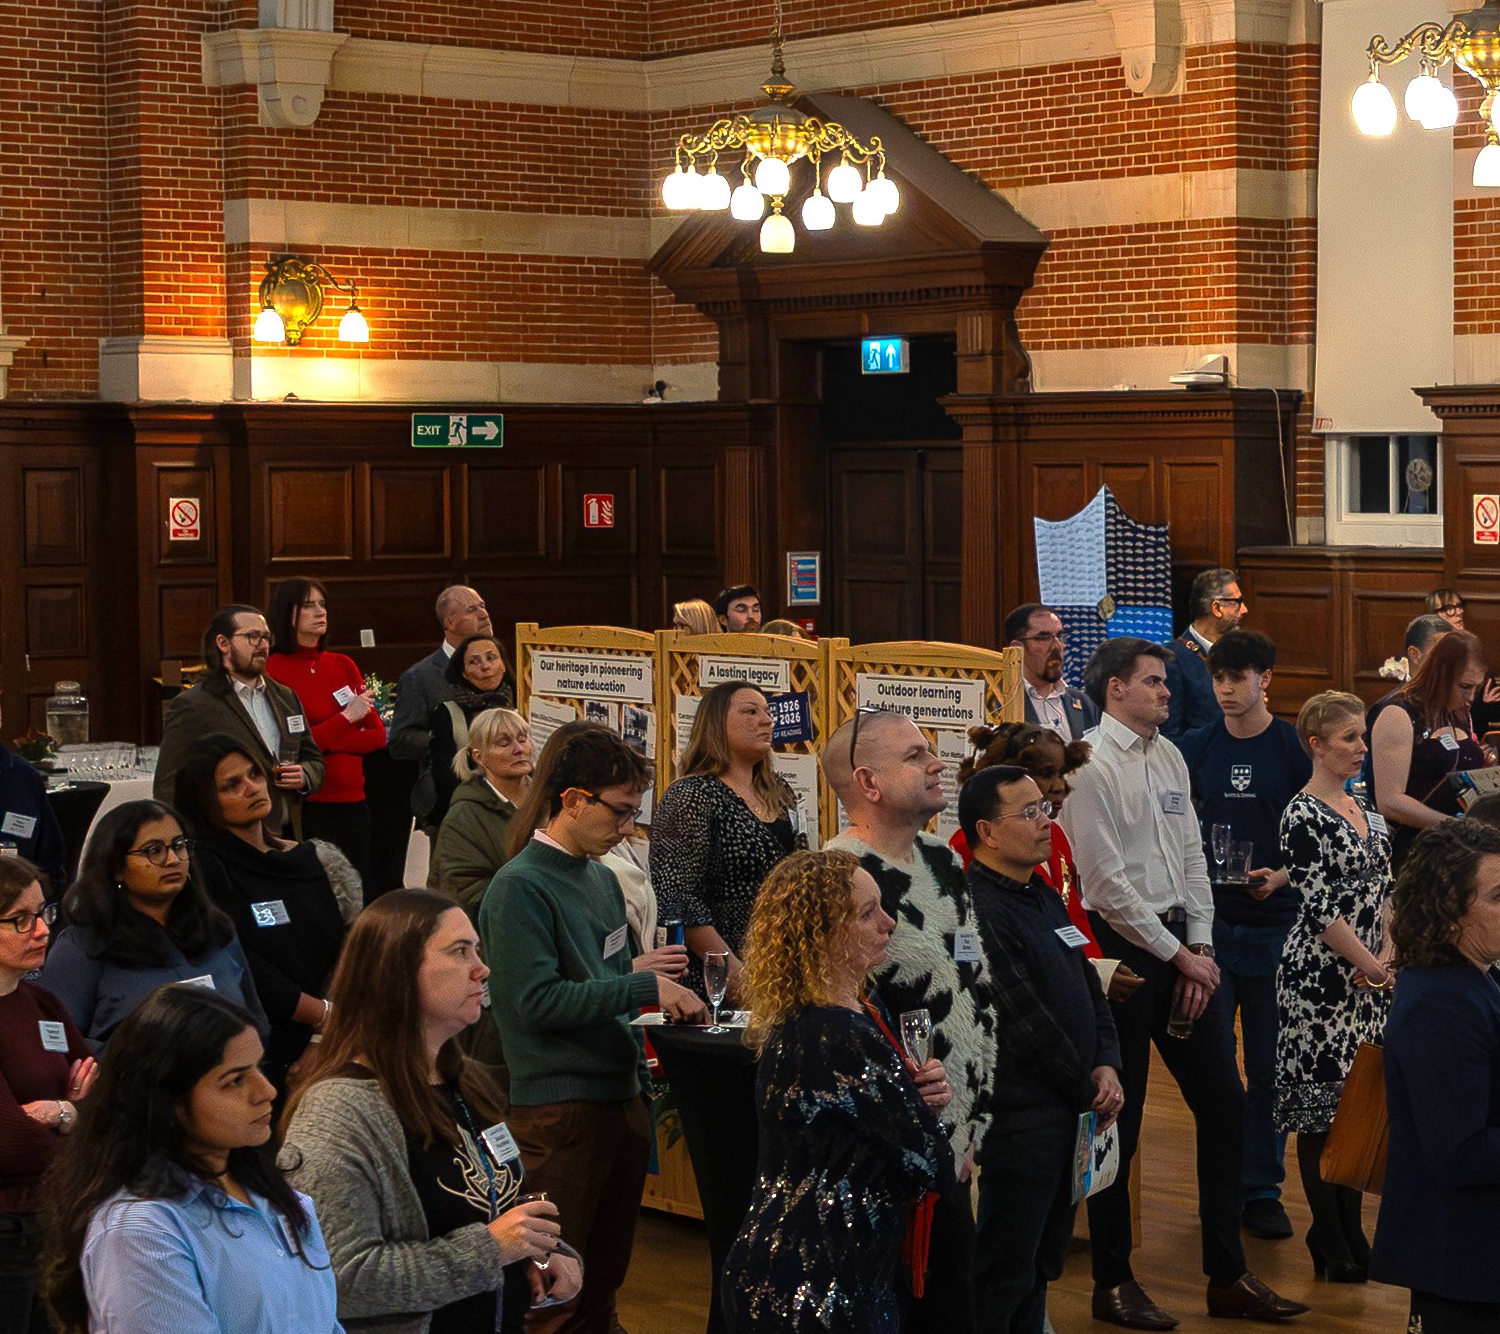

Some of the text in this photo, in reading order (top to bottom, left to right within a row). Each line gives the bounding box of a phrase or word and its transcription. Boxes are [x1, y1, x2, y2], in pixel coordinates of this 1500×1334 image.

[417, 425, 441, 435] EXIT
[540, 659, 642, 680] Our heritage in pioneering
[708, 665, 780, 684] A lasting legacy
[556, 678, 626, 694] nature education
[878, 683, 962, 704] Outdoor learning
[778, 700, 800, 713] 1926
[912, 704, 974, 720] generations
[779, 712, 801, 725] 2026
